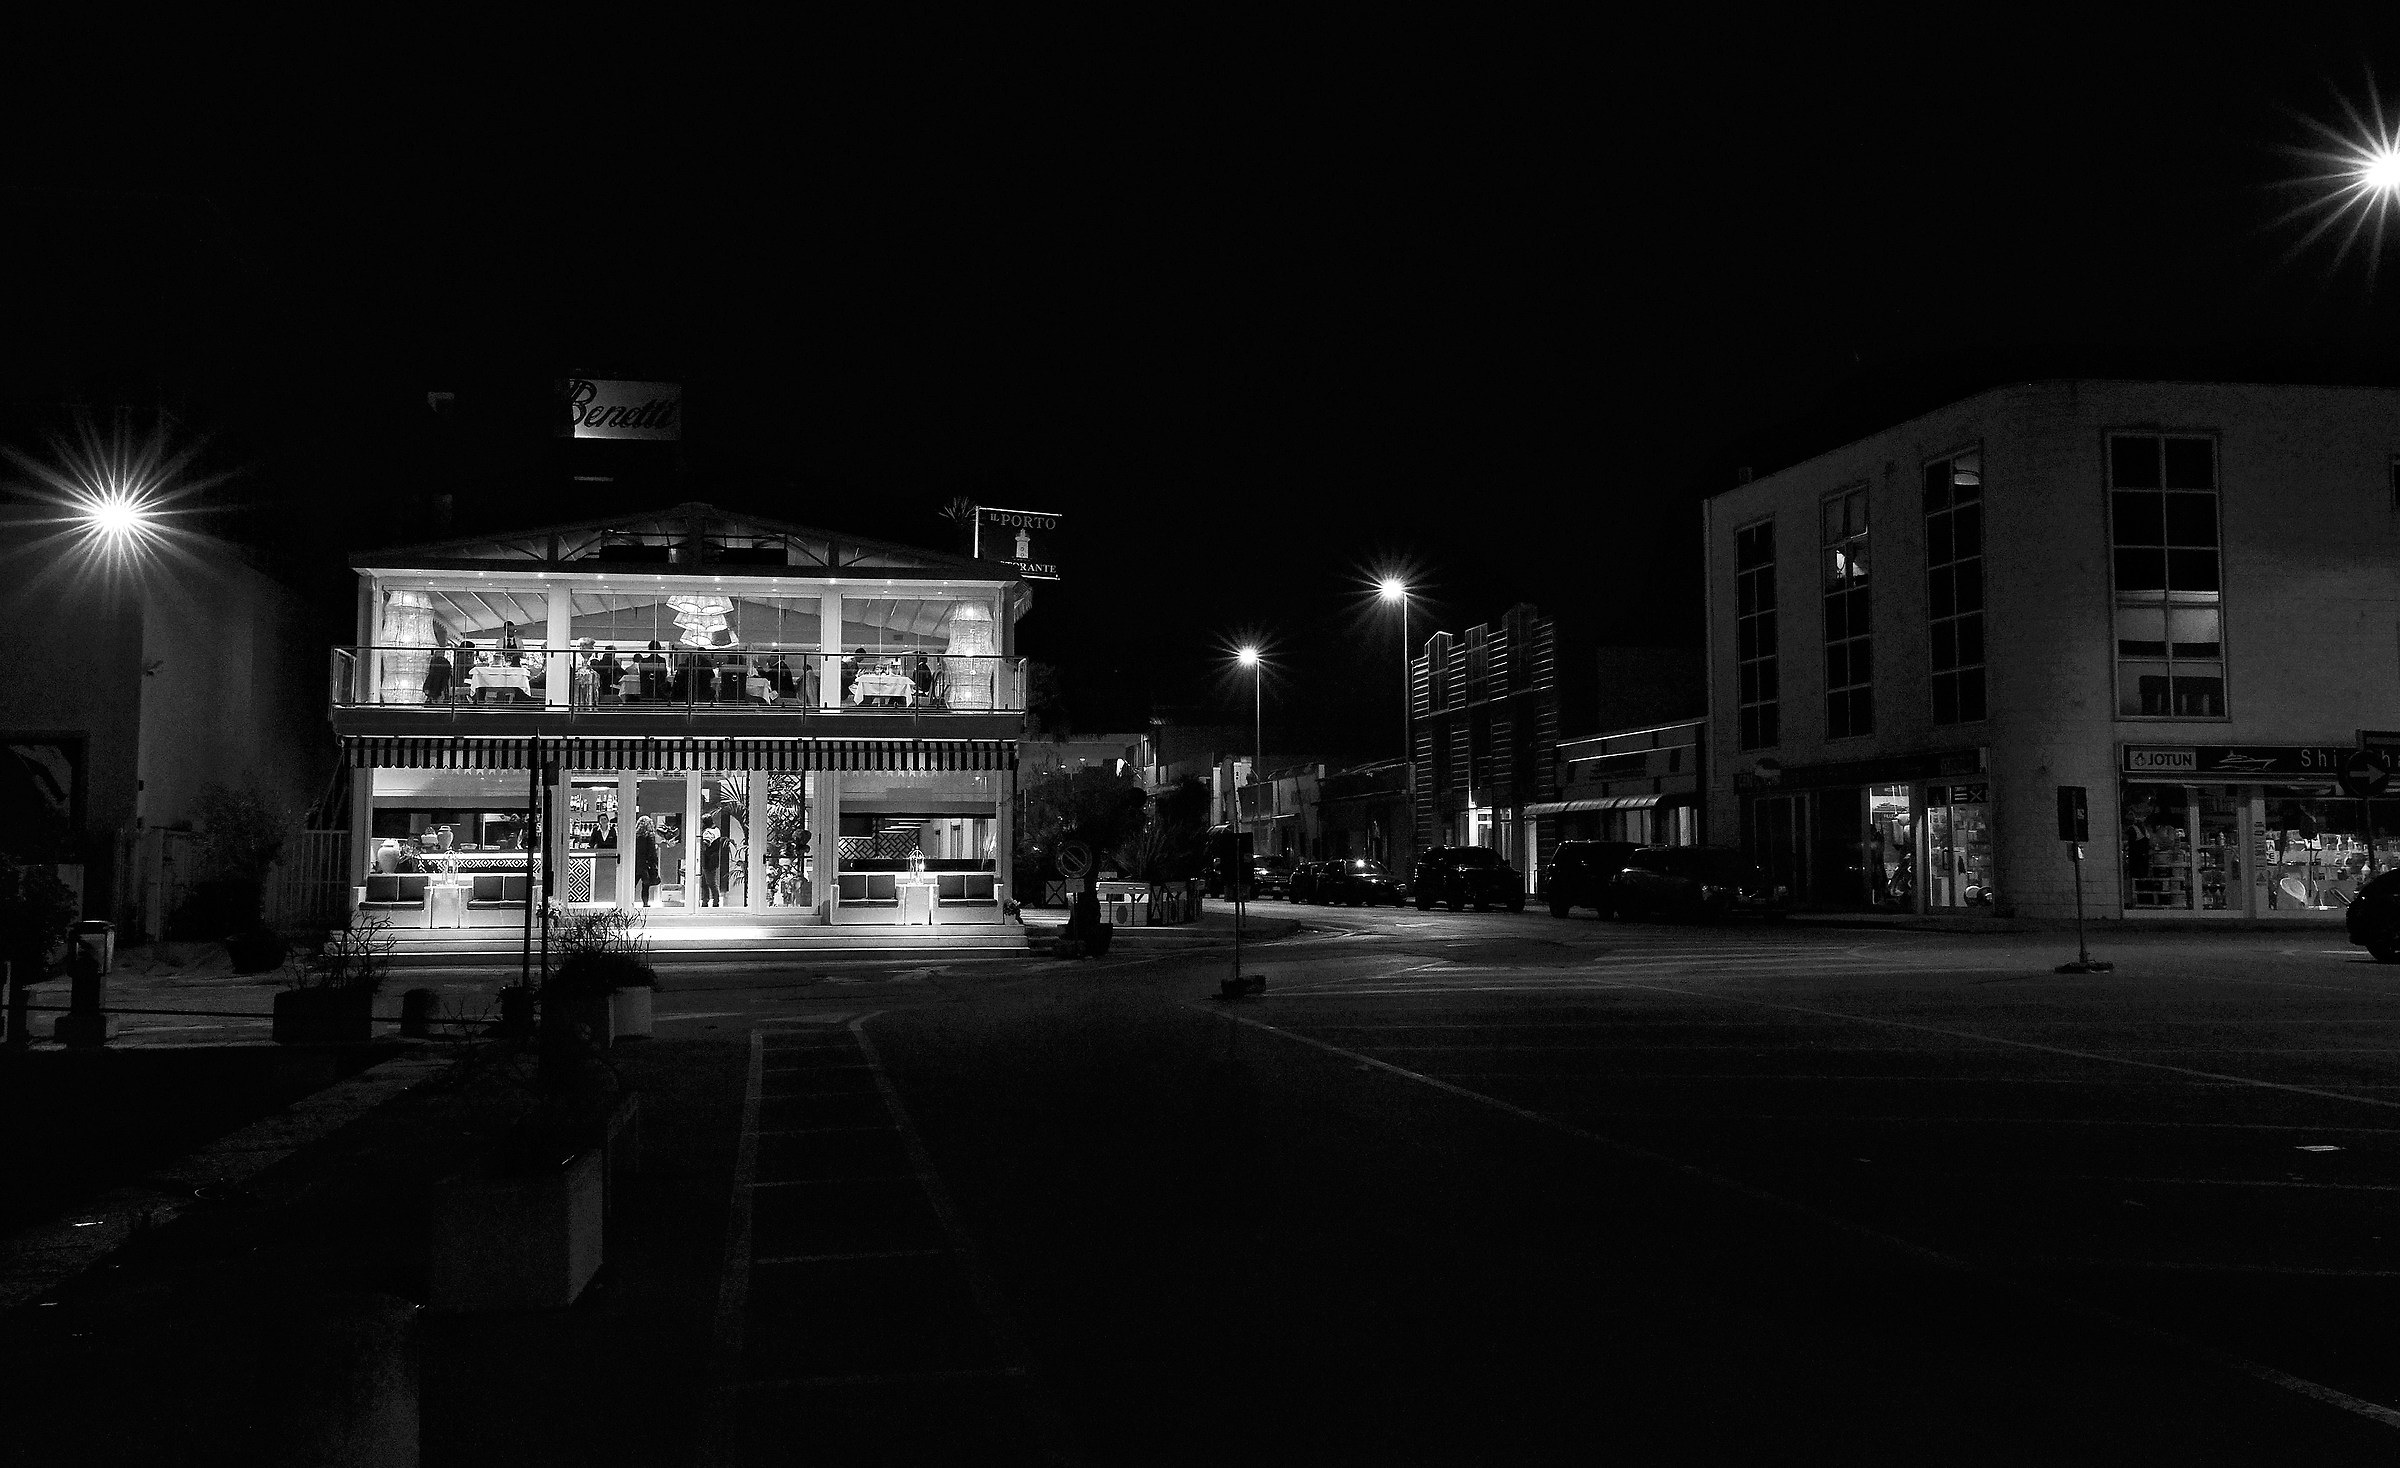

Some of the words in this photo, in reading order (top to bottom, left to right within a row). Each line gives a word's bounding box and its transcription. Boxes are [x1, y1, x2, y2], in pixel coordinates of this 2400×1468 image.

[1000, 513, 1057, 530] PORTO
[1000, 561, 1057, 573] RANTE
[2147, 753, 2193, 767] JOTUN
[2300, 748, 2338, 768] Shi
